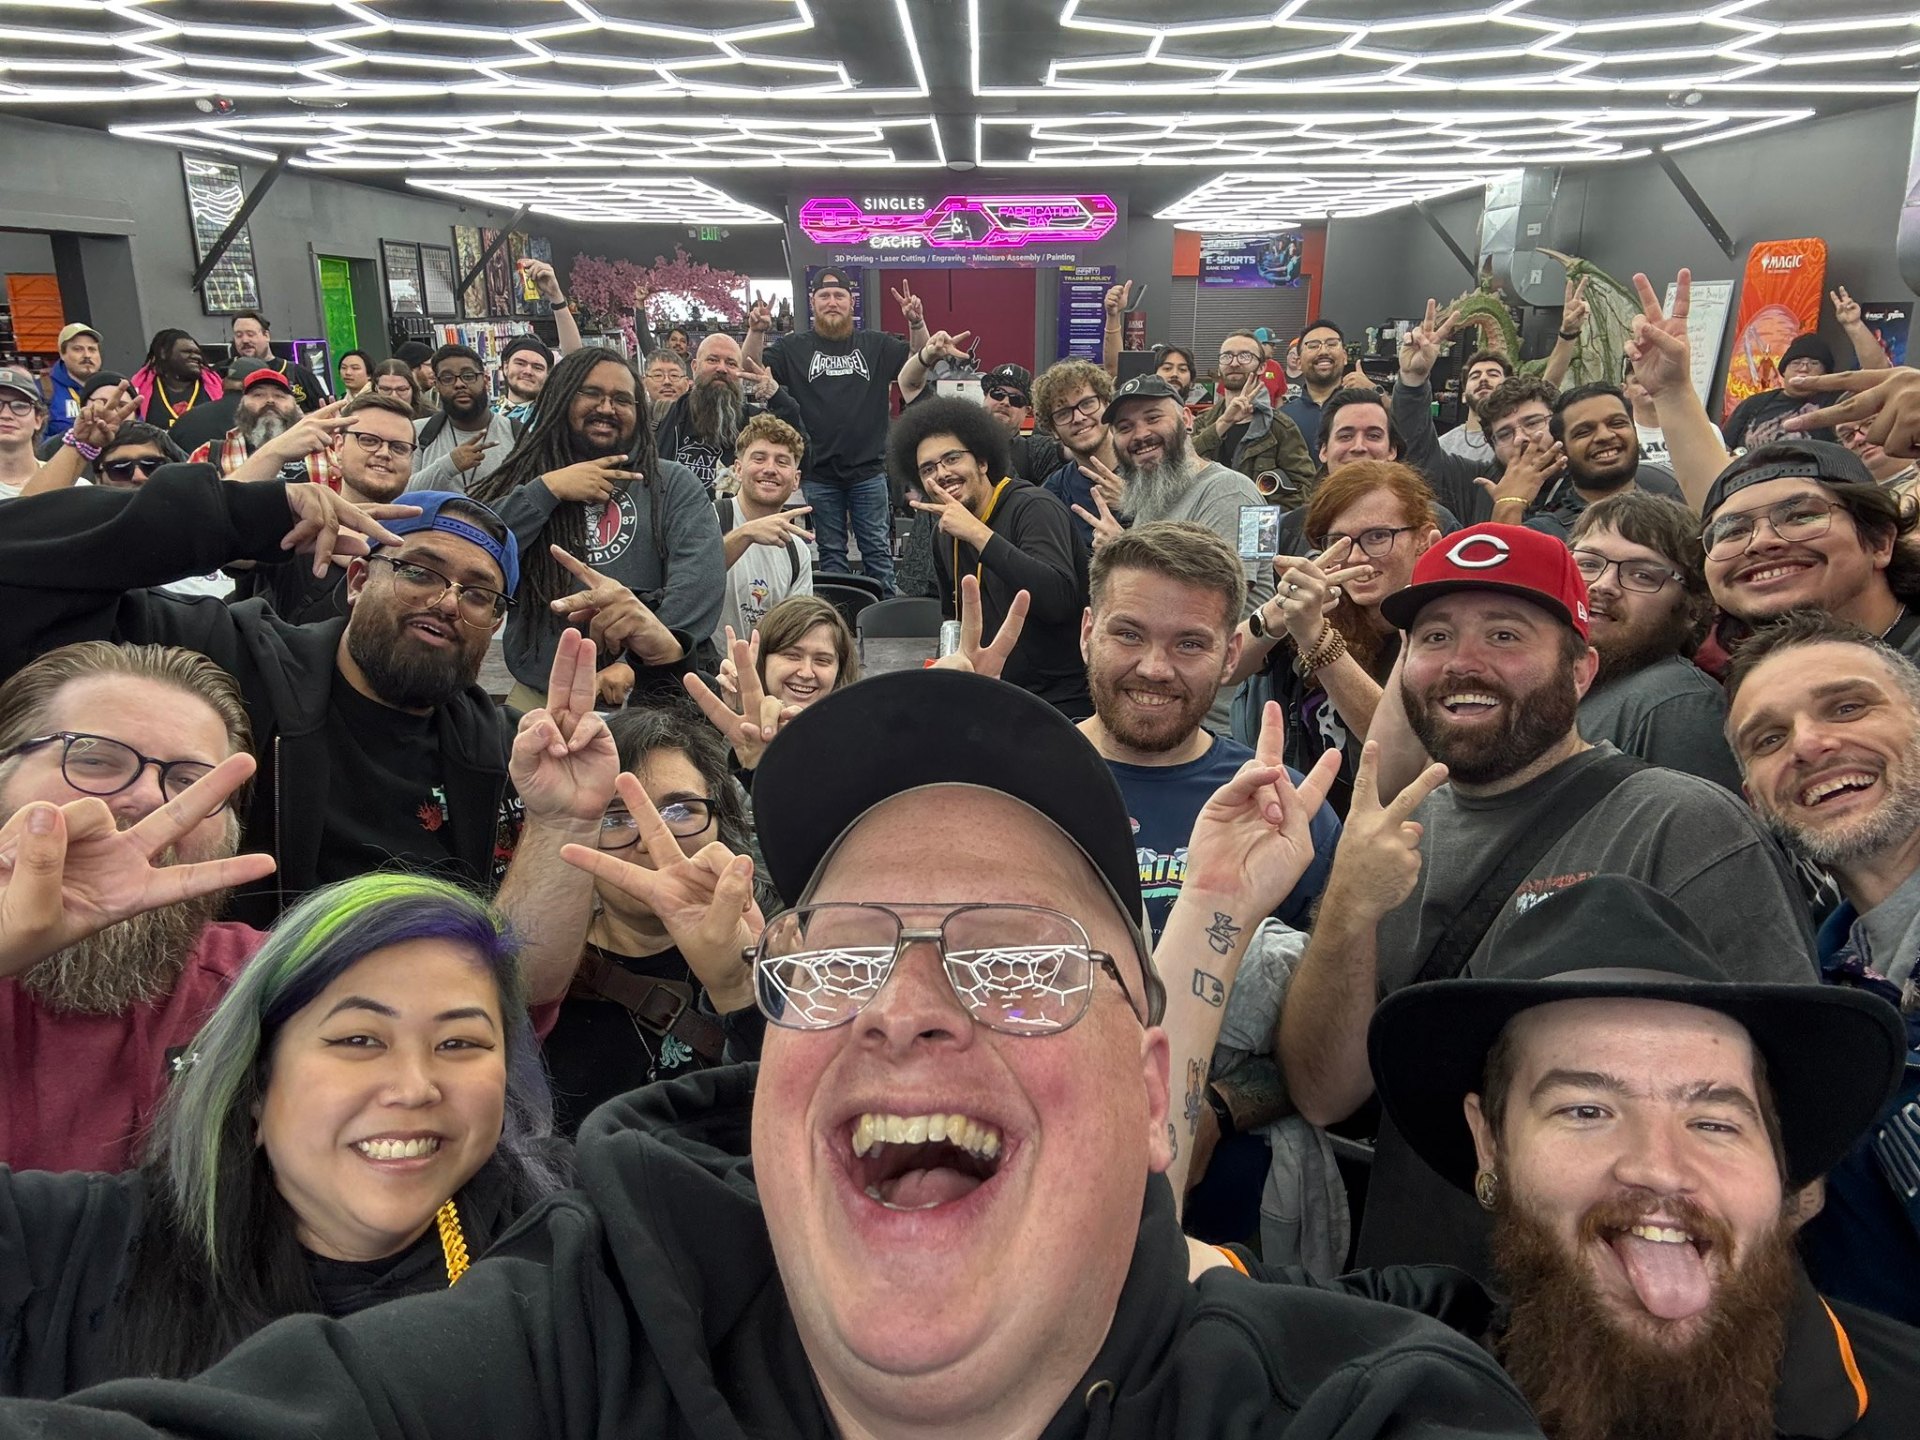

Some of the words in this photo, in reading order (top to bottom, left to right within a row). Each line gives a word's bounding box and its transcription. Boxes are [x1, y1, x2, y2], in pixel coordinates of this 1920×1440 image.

[863, 197, 926, 211] SINGLES
[998, 205, 1080, 218] FABRICATION
[951, 217, 964, 234] &
[1027, 216, 1054, 228] BAY
[701, 226, 719, 241] EXIT
[869, 235, 922, 250] CACHE
[835, 254, 845, 262] 3D
[846, 254, 874, 264] Printing
[880, 254, 900, 262] Laser
[900, 254, 926, 264] Cutting
[931, 254, 967, 264] Engraving
[972, 254, 1005, 262] Miniature
[1006, 253, 1041, 263] Assembly
[1046, 253, 1076, 263] Painting
[1206, 254, 1256, 265] E-SPORTS
[1768, 254, 1803, 269] MAGIC
[811, 351, 867, 375] ARCHANGEL
[677, 452, 717, 467] PLAY
[622, 516, 636, 525] 87
[1446, 533, 1510, 570] C
